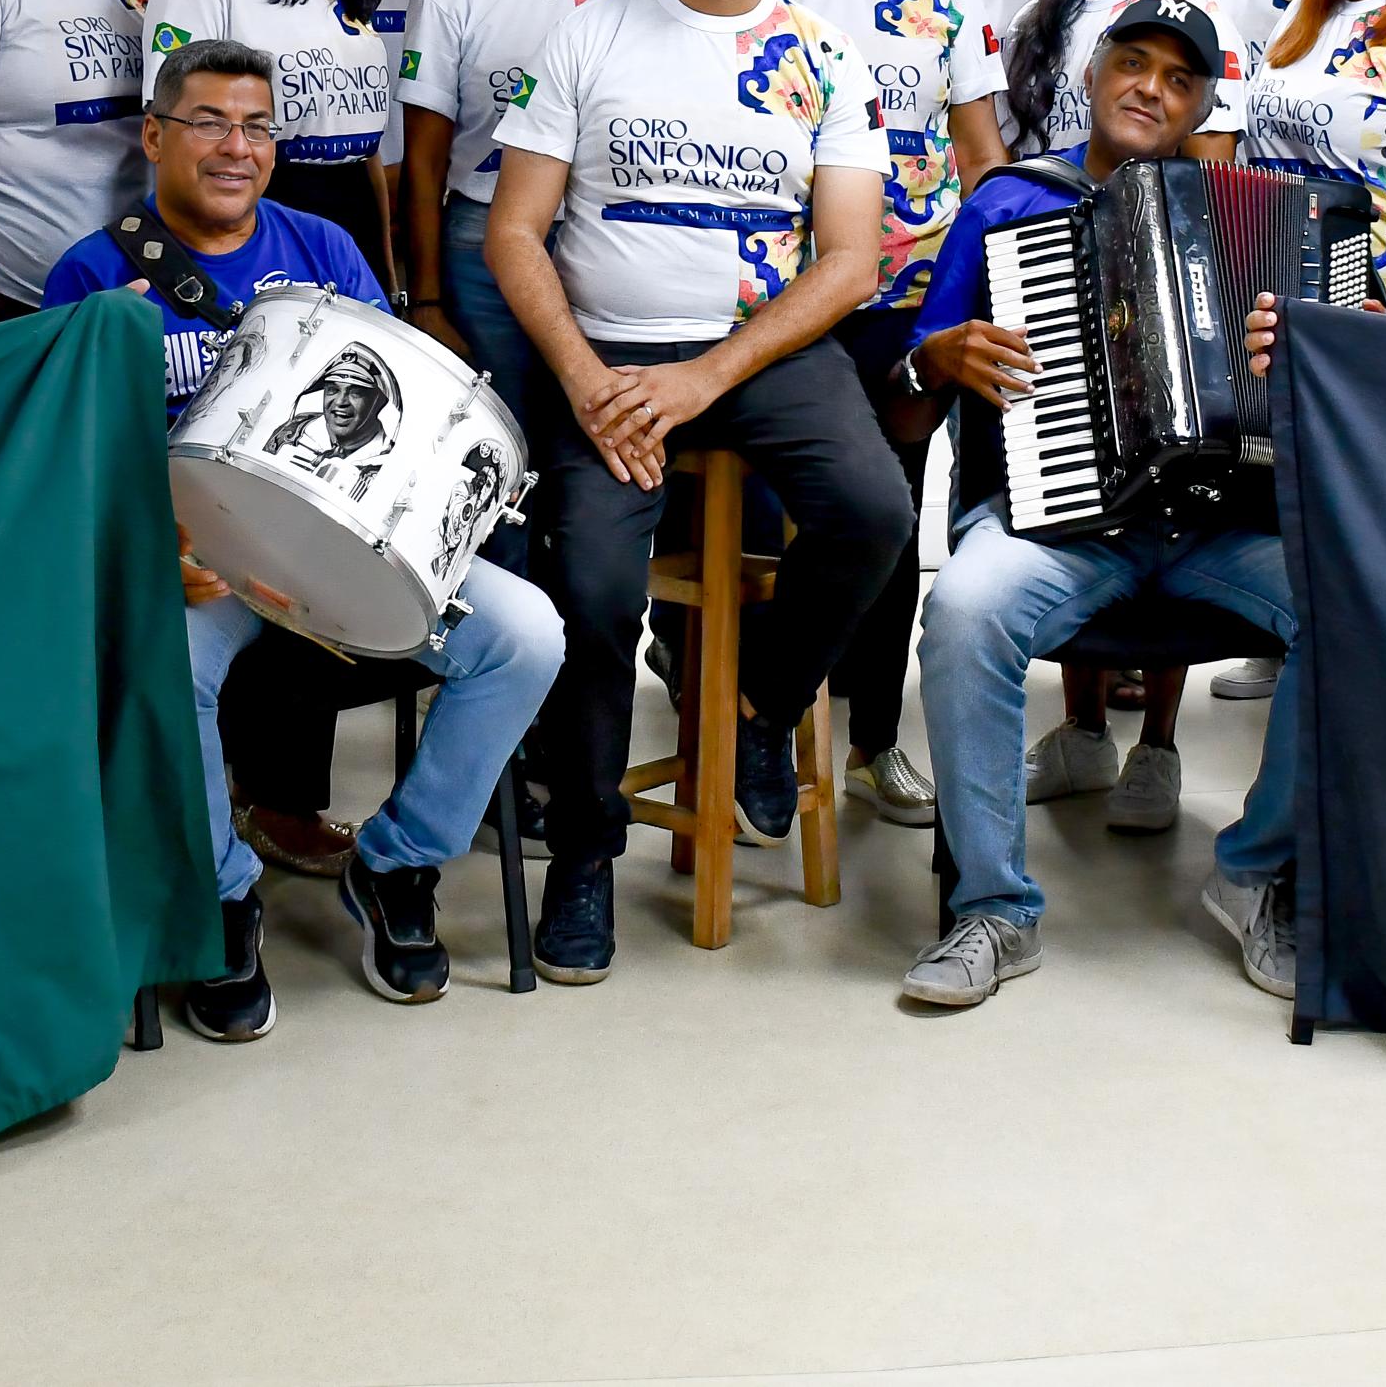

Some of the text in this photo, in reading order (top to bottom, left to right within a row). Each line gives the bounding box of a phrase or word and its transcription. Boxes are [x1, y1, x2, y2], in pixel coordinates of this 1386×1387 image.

[58, 16, 113, 35] CORO
[69, 59, 108, 82] DA
[278, 47, 334, 72] CORO
[489, 66, 524, 89] CO
[283, 96, 318, 122] DA
[609, 117, 688, 139] CORO
[611, 167, 654, 187] DA
